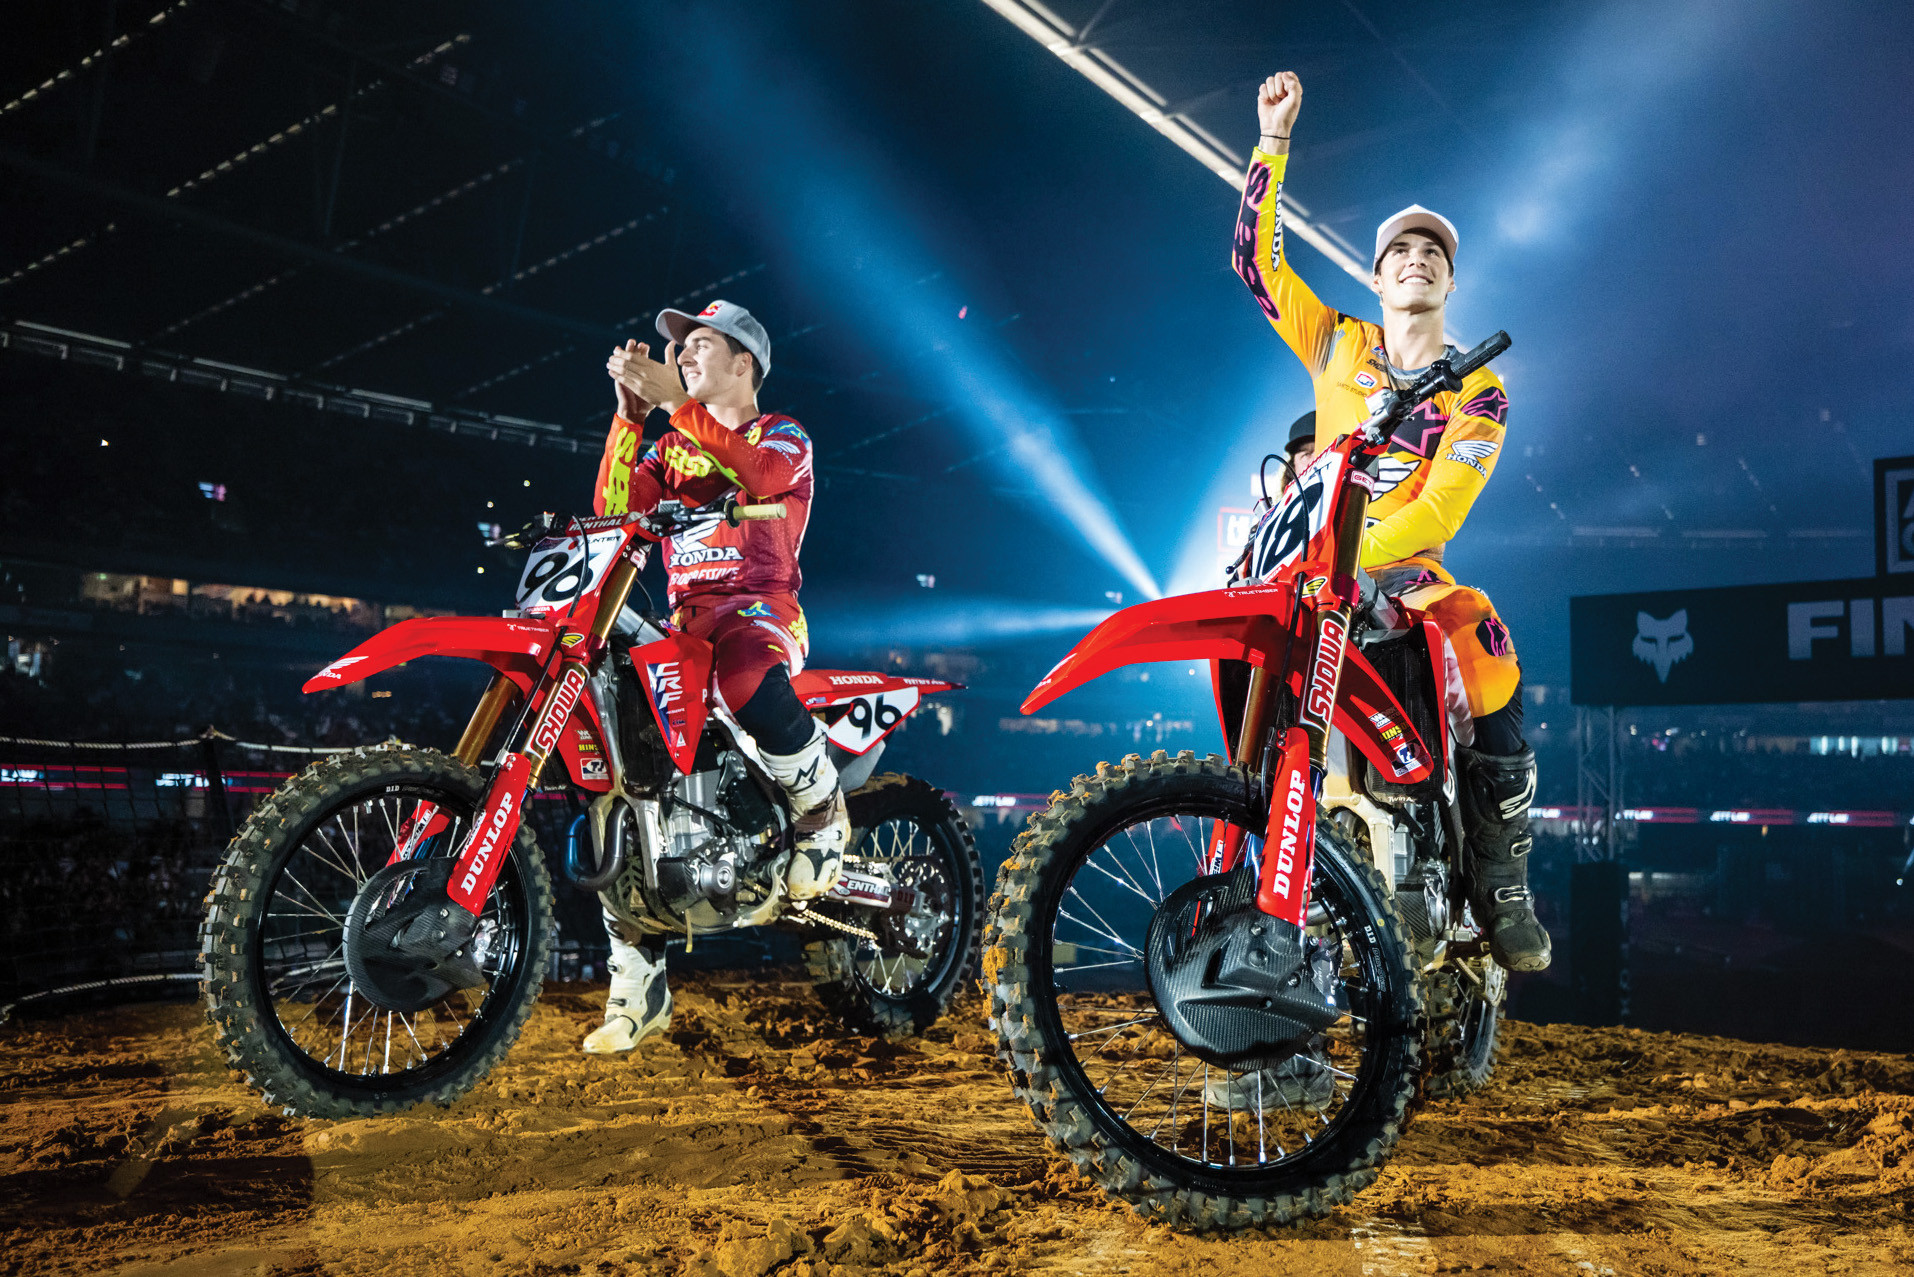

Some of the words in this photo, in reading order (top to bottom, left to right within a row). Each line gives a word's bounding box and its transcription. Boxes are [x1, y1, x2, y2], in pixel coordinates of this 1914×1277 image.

[1271, 181, 1284, 271] HONDA
[1445, 453, 1487, 479] HONDA
[1255, 481, 1324, 579] 18
[517, 551, 602, 602] 96
[530, 672, 585, 758] SHOWA
[828, 675, 885, 686] HONDA
[846, 693, 904, 740] 96
[1303, 620, 1344, 728] SHOWA
[460, 791, 514, 896] DUNLOP
[1273, 769, 1307, 900] DUNLOP
